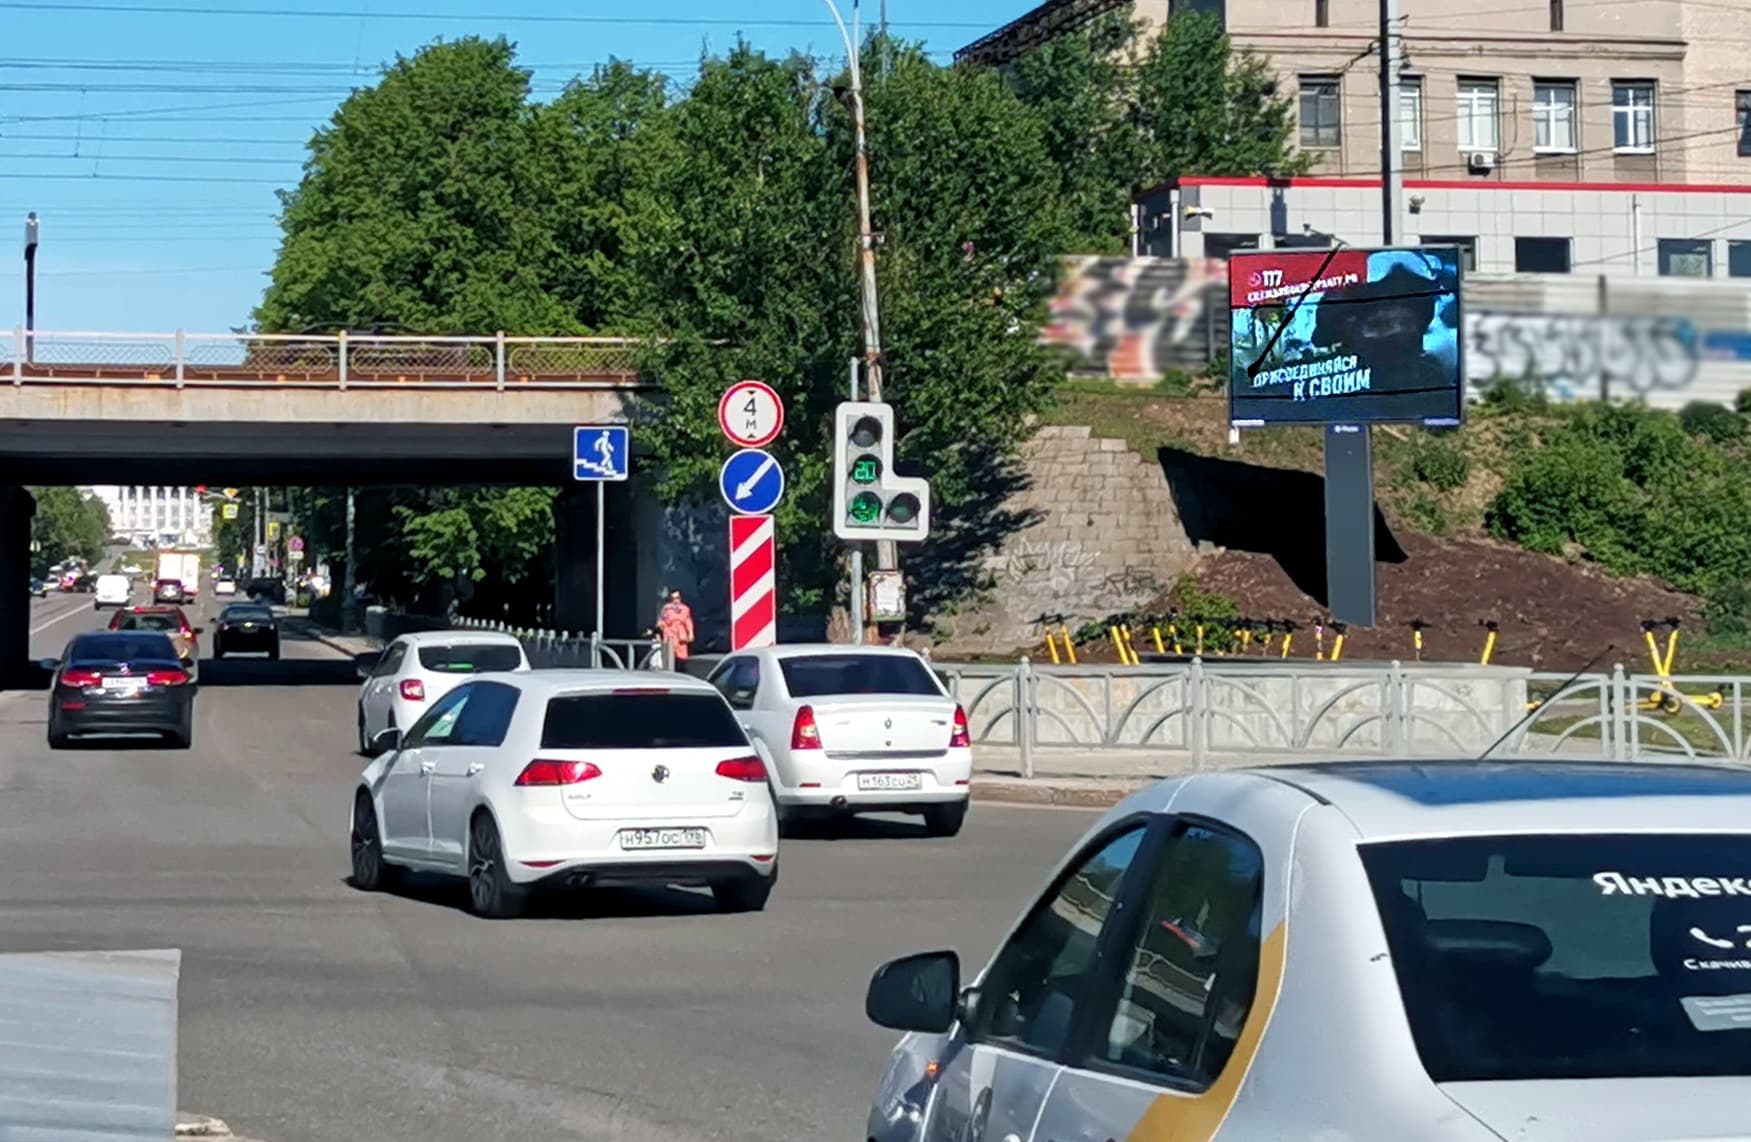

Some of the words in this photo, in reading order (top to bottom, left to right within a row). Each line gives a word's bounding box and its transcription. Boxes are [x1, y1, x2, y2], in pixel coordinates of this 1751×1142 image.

[1293, 381, 1305, 400] К
[1309, 368, 1371, 398] СВОИМ
[744, 397, 756, 416] 4
[854, 460, 876, 480] 20
[1593, 871, 1751, 898] Яндек
